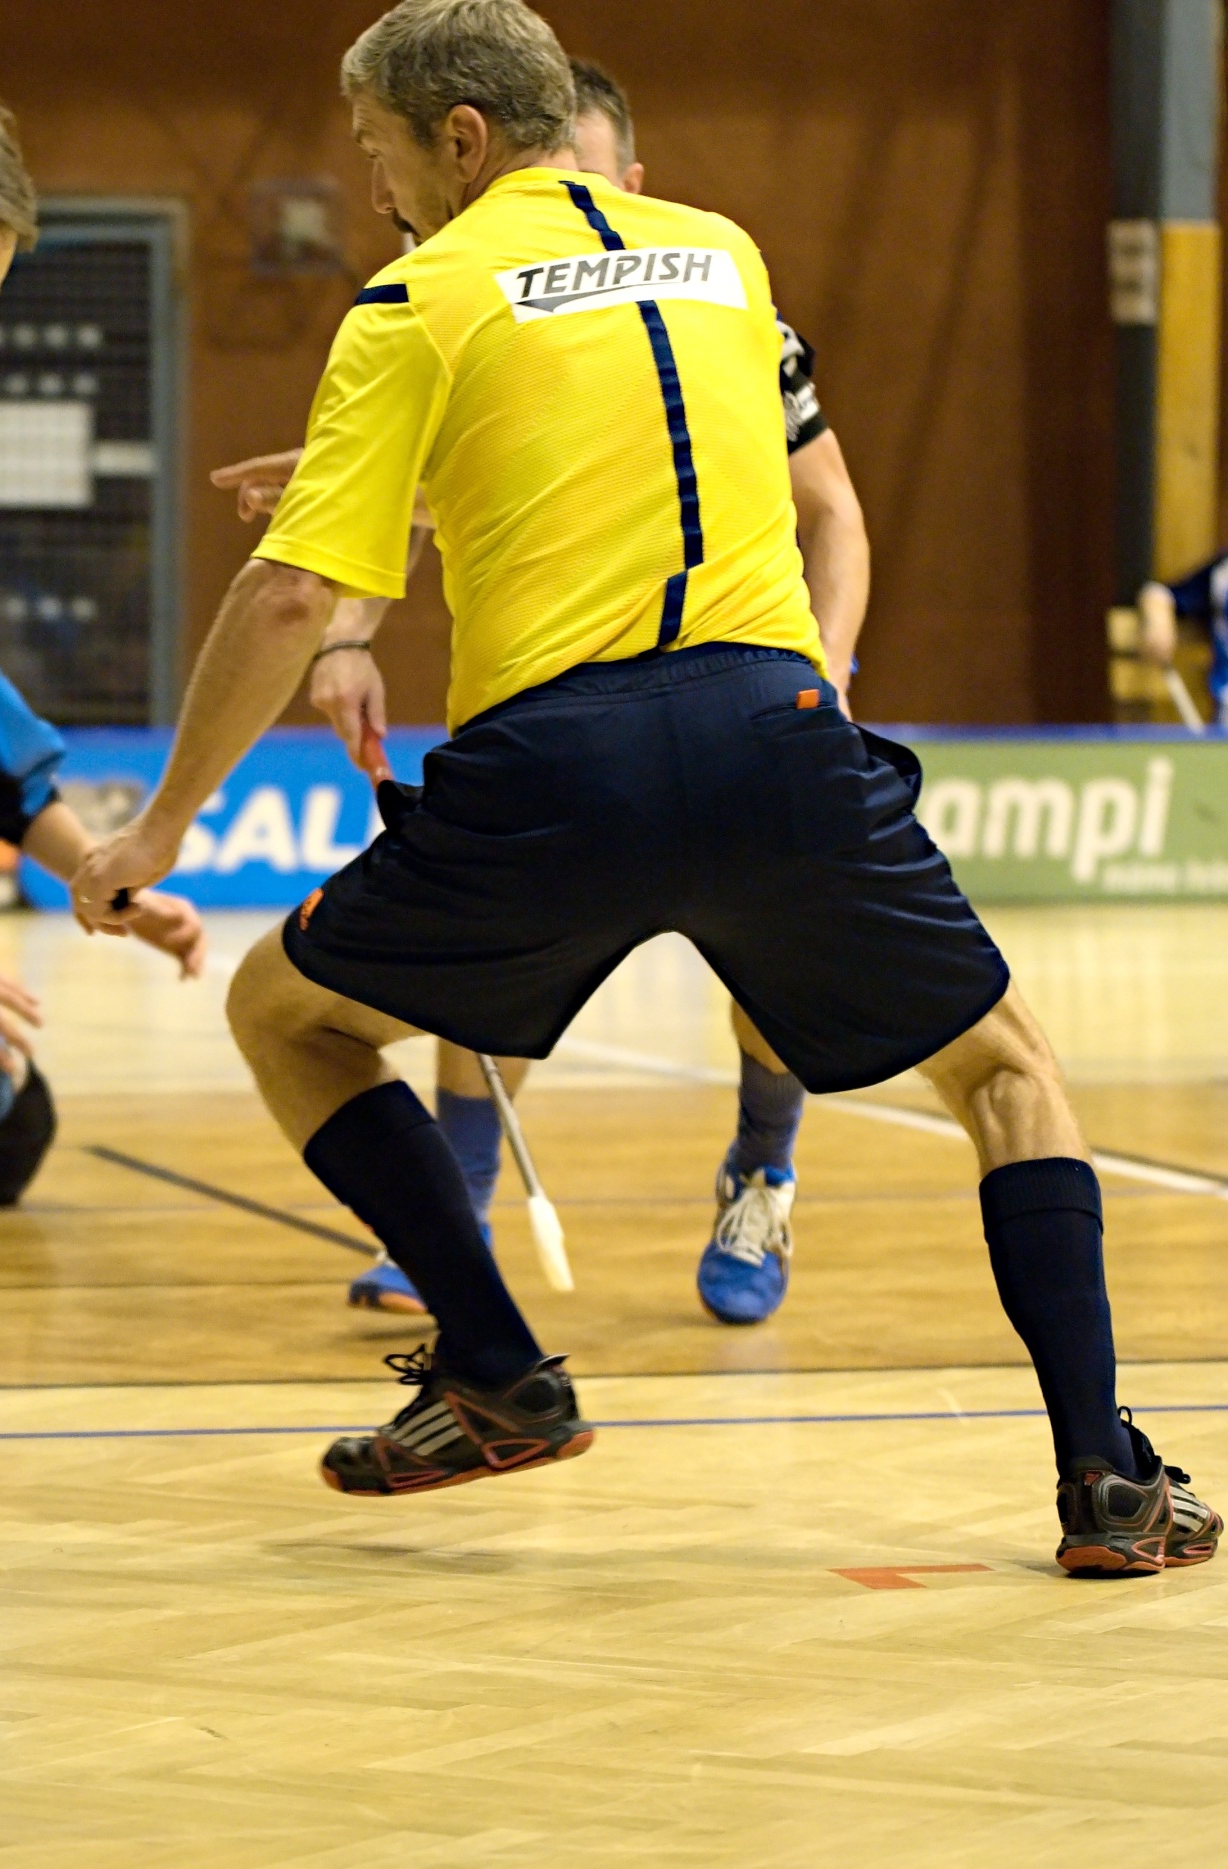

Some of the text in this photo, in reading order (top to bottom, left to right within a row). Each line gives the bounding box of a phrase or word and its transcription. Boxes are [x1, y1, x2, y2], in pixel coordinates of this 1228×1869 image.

[516, 252, 712, 298] TEMPISH
[174, 786, 386, 874] SAL
[922, 758, 1174, 884] ampi
